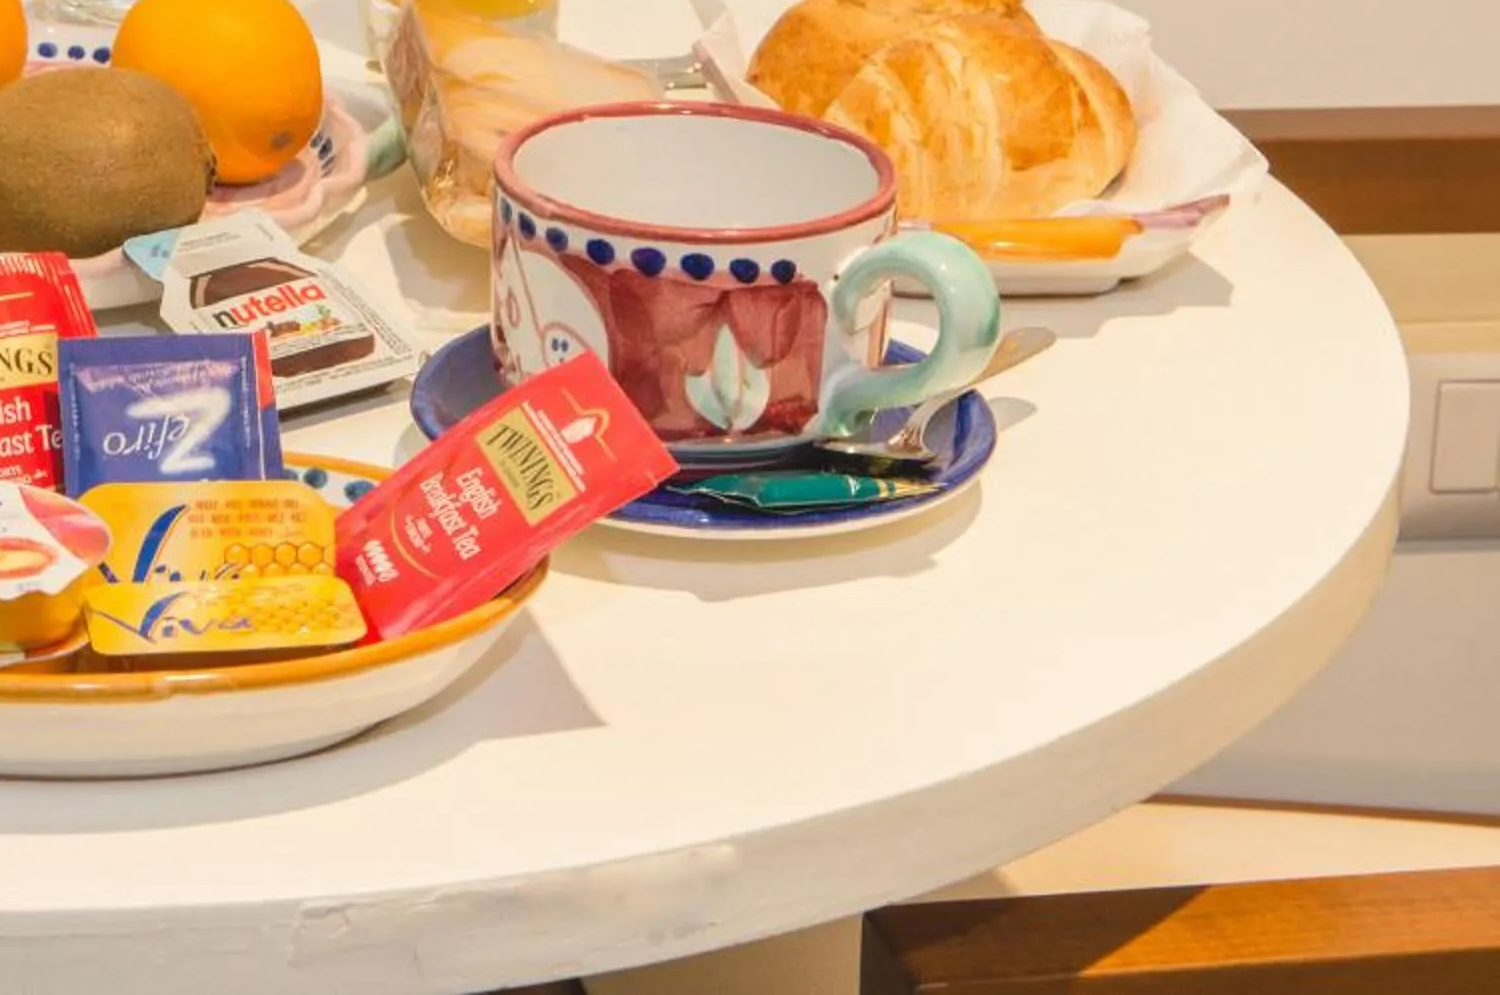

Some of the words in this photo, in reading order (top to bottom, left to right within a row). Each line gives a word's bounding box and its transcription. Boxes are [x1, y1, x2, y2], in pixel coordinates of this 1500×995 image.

[212, 282, 326, 328] nutella
[35, 425, 62, 451] Te
[102, 386, 232, 474] Zefiro
[455, 468, 504, 520] English
[486, 423, 555, 511] TWININGS
[420, 471, 466, 539] Breakfast
[451, 523, 481, 561] Tea
